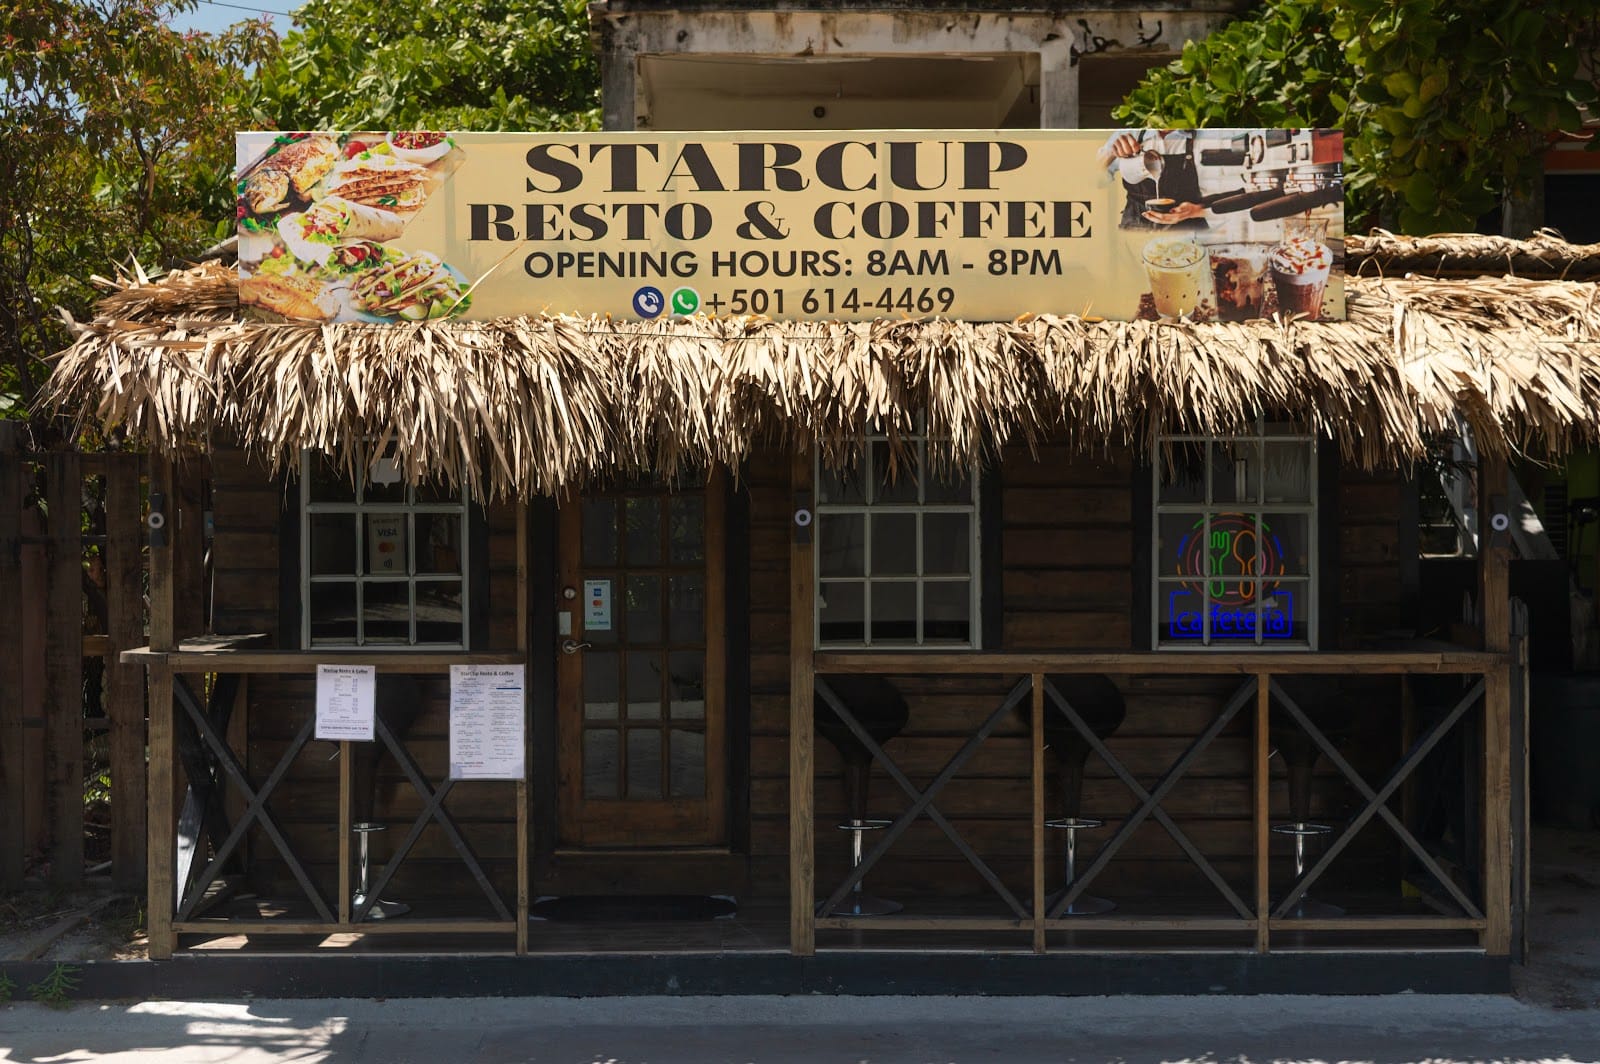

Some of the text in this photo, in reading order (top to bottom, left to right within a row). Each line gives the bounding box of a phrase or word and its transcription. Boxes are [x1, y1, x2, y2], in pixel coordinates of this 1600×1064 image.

[525, 141, 1028, 194] STARCUP
[467, 200, 1092, 242] RESTO & COFFEE
[524, 250, 699, 279] OPENING
[711, 249, 853, 278] HOURS:
[866, 249, 950, 277] 8AM
[987, 249, 1063, 276] 8PM
[704, 286, 956, 315] +501 614-4469
